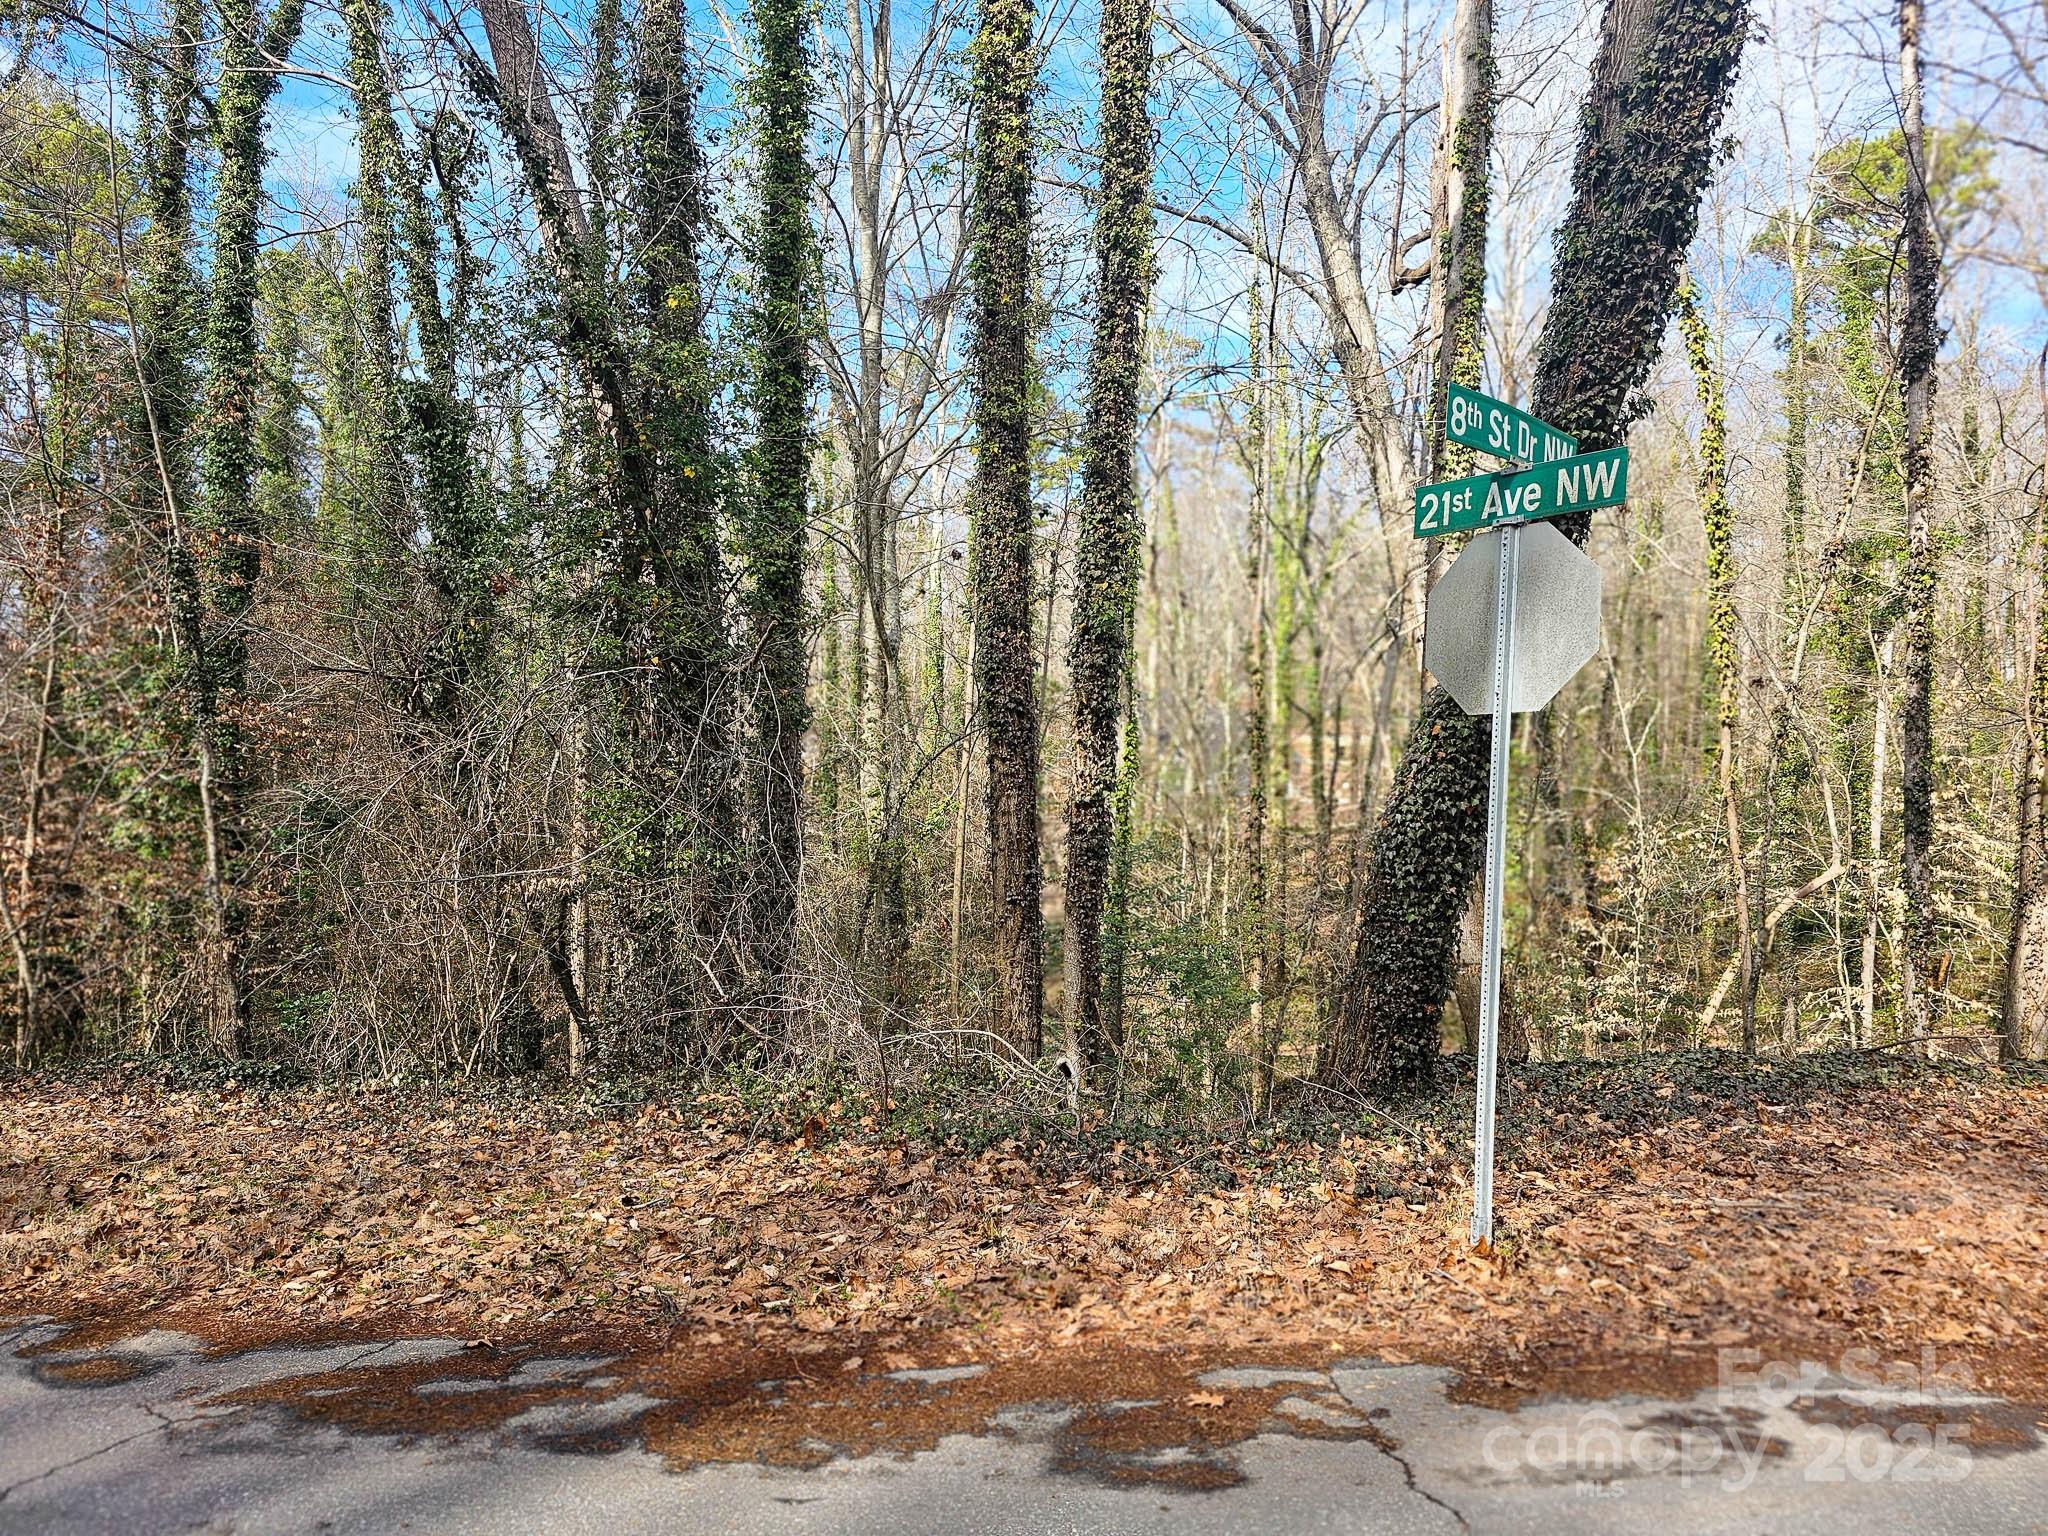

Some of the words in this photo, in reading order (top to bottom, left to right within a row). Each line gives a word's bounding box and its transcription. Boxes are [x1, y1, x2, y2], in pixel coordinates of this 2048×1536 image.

[1451, 397, 1483, 436] 8th
[1488, 409, 1511, 451] St
[1518, 419, 1537, 461] Dr
[1544, 432, 1574, 462] NW
[1419, 487, 1472, 530] 21st
[1480, 481, 1542, 520] Ave
[1556, 458, 1621, 506] NW
